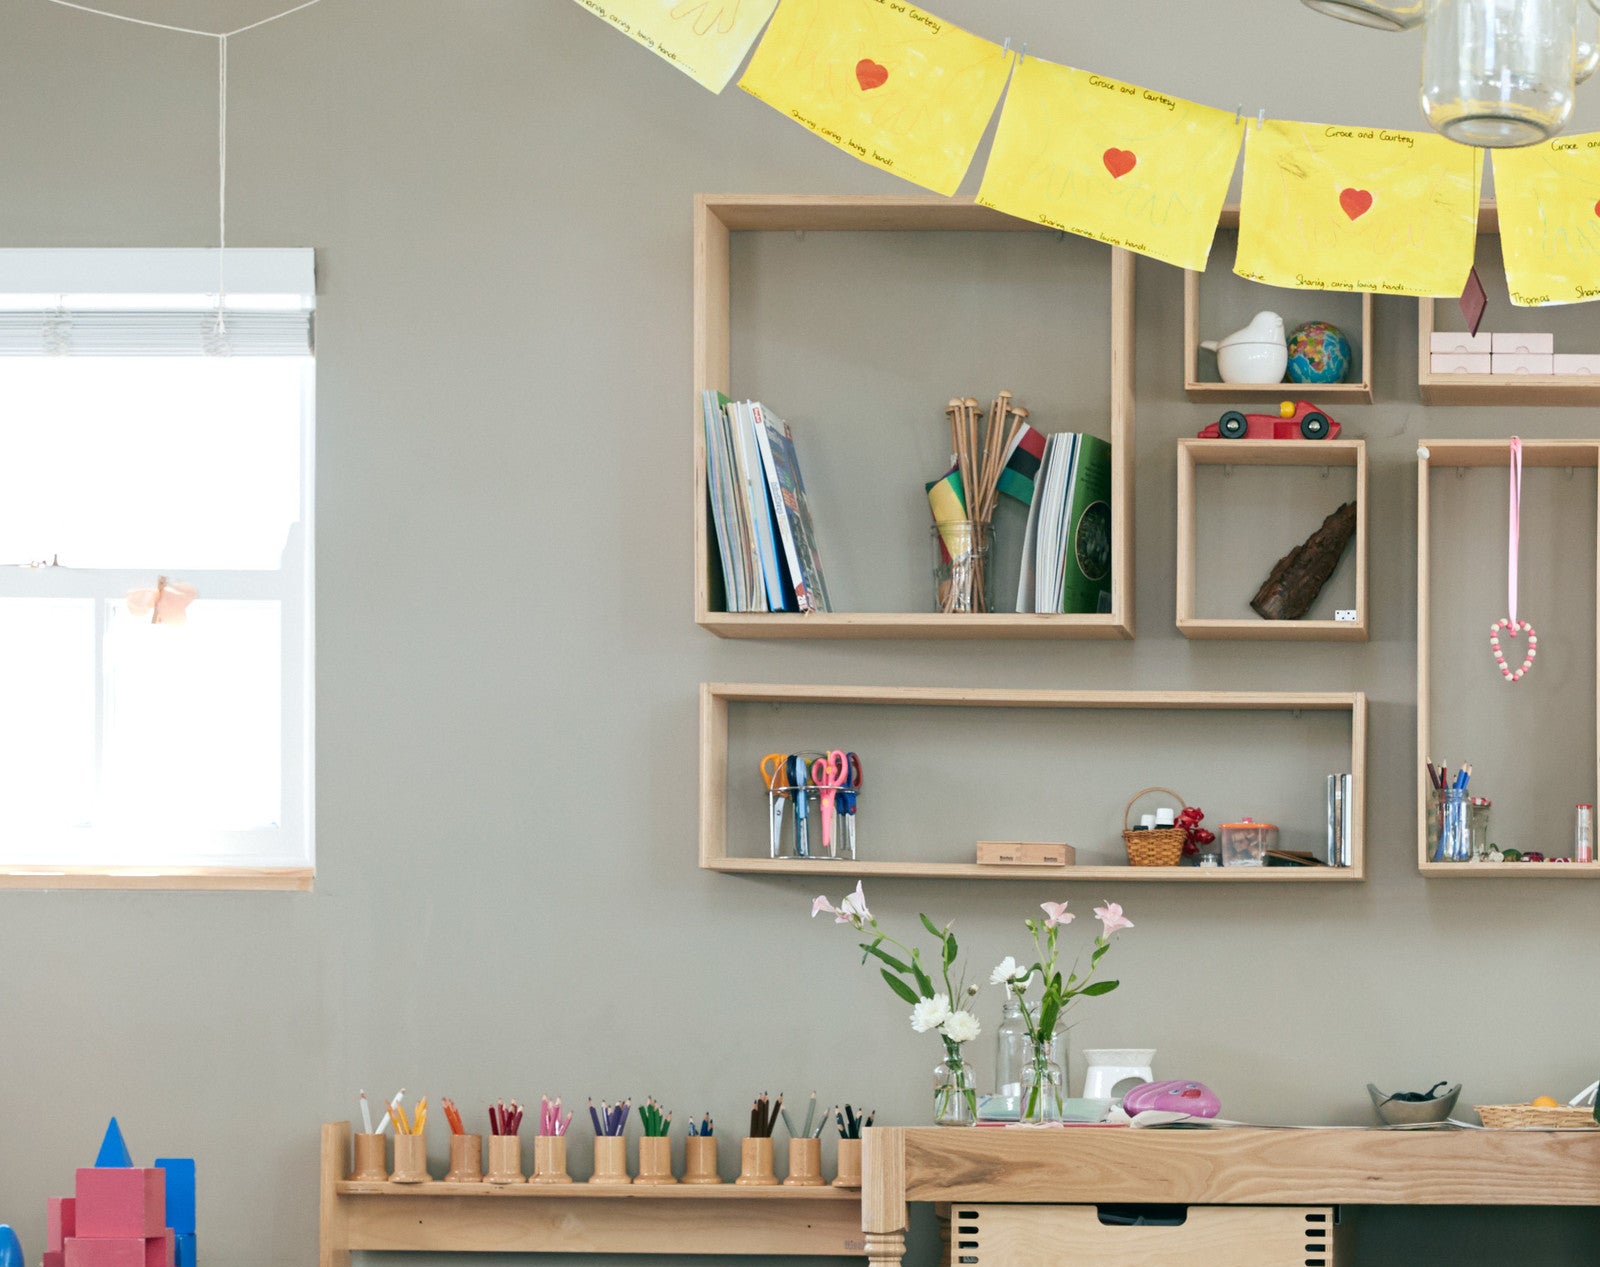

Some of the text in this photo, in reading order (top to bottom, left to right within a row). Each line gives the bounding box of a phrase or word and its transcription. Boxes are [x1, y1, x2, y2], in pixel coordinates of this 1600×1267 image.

[890, 3, 941, 34] and Courtesy
[1089, 75, 1176, 111] Grace and Courtesy
[1325, 126, 1414, 149] Grace and Courtesy
[1551, 139, 1578, 151] Grace
[1511, 292, 1551, 307] Thomas
